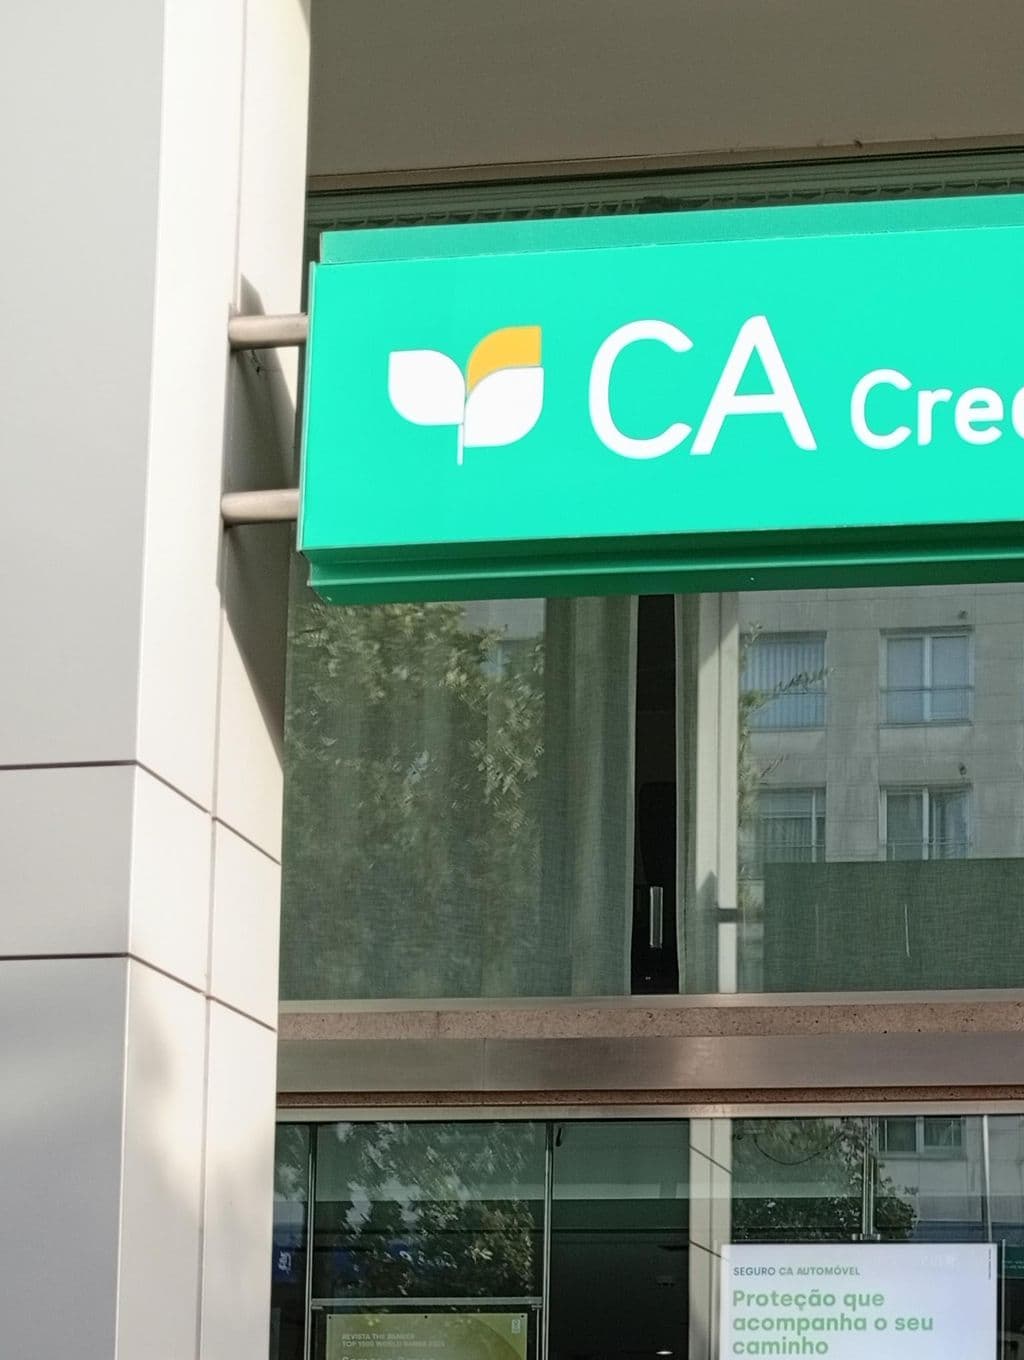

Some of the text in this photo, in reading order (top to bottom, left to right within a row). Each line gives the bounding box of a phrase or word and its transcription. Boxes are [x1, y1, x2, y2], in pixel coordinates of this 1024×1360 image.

[588, 315, 817, 459] CA
[733, 1264, 861, 1276] SEGURO CA AUTOMÓVEL
[732, 1288, 885, 1311] Proteção que
[732, 1313, 934, 1335] acompanha o seu
[732, 1336, 829, 1355] caminho
